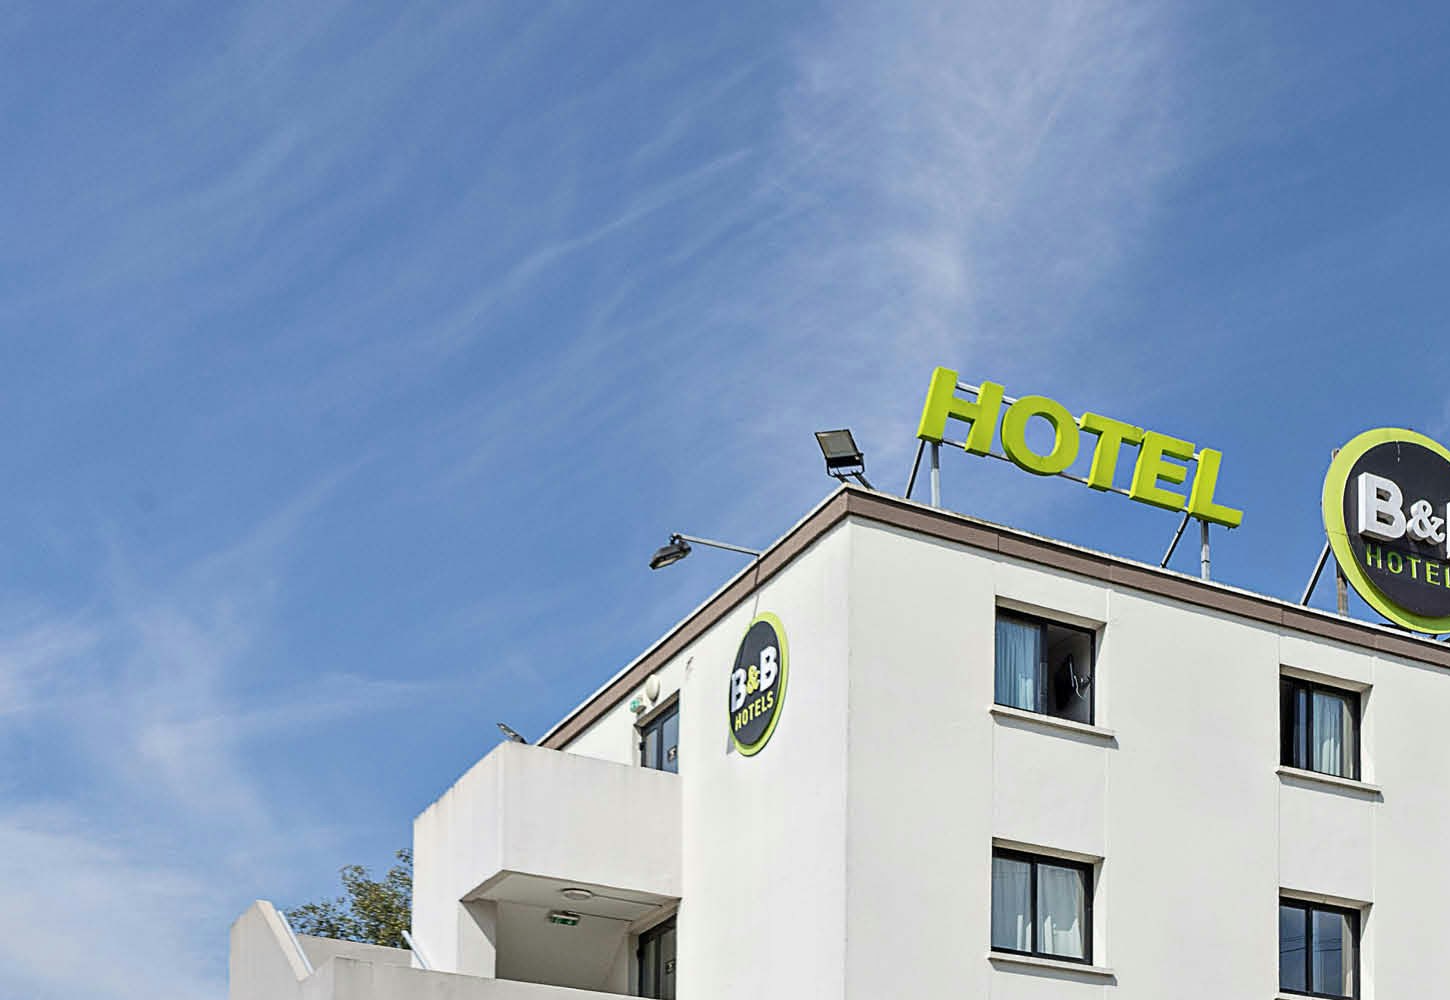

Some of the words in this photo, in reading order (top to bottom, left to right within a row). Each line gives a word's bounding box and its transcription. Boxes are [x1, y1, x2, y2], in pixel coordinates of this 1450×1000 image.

[917, 367, 1244, 530] HOTEL
[731, 645, 778, 713] B&B
[734, 690, 774, 731] HOTELS
